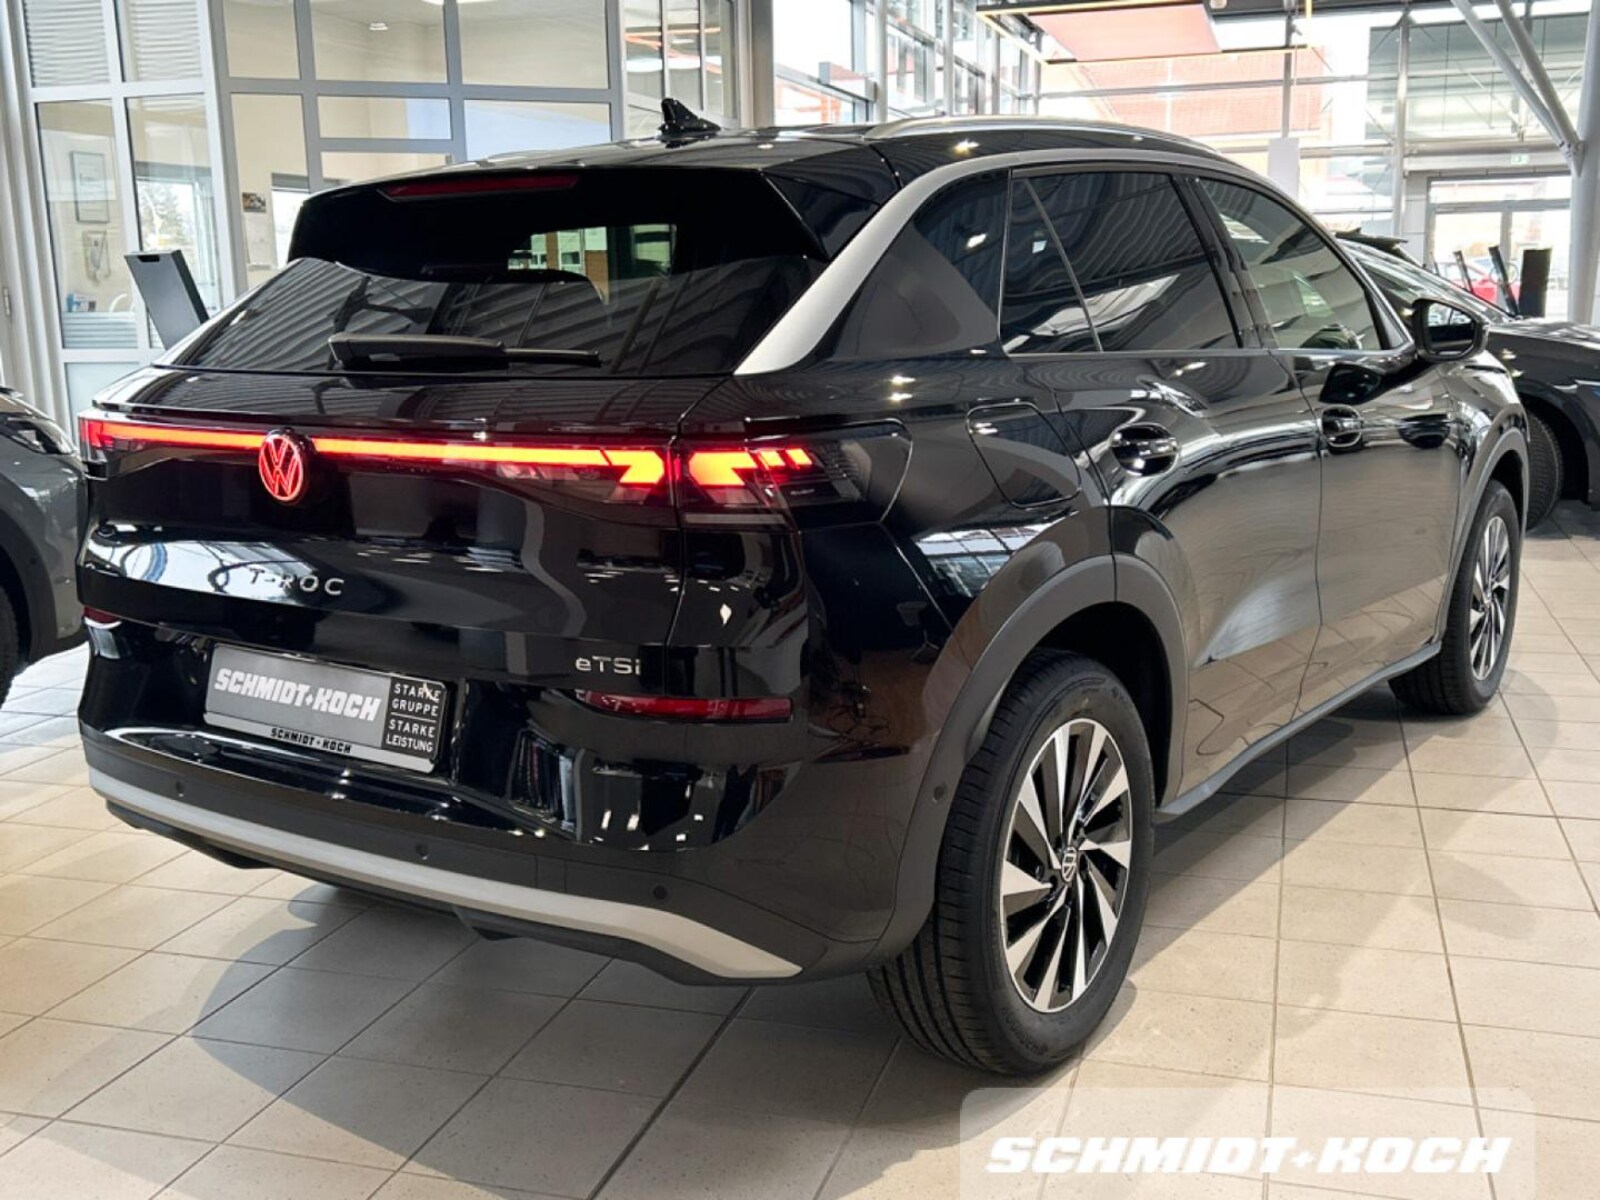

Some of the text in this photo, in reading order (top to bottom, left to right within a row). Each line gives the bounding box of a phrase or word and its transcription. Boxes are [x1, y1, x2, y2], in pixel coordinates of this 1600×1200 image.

[250, 567, 345, 596] T-ROC
[575, 655, 641, 675] eTSi
[394, 682, 442, 703] STARKE
[391, 698, 439, 717] GRUPPE
[388, 718, 436, 738] STARKE
[385, 733, 433, 753] LEISTUNG
